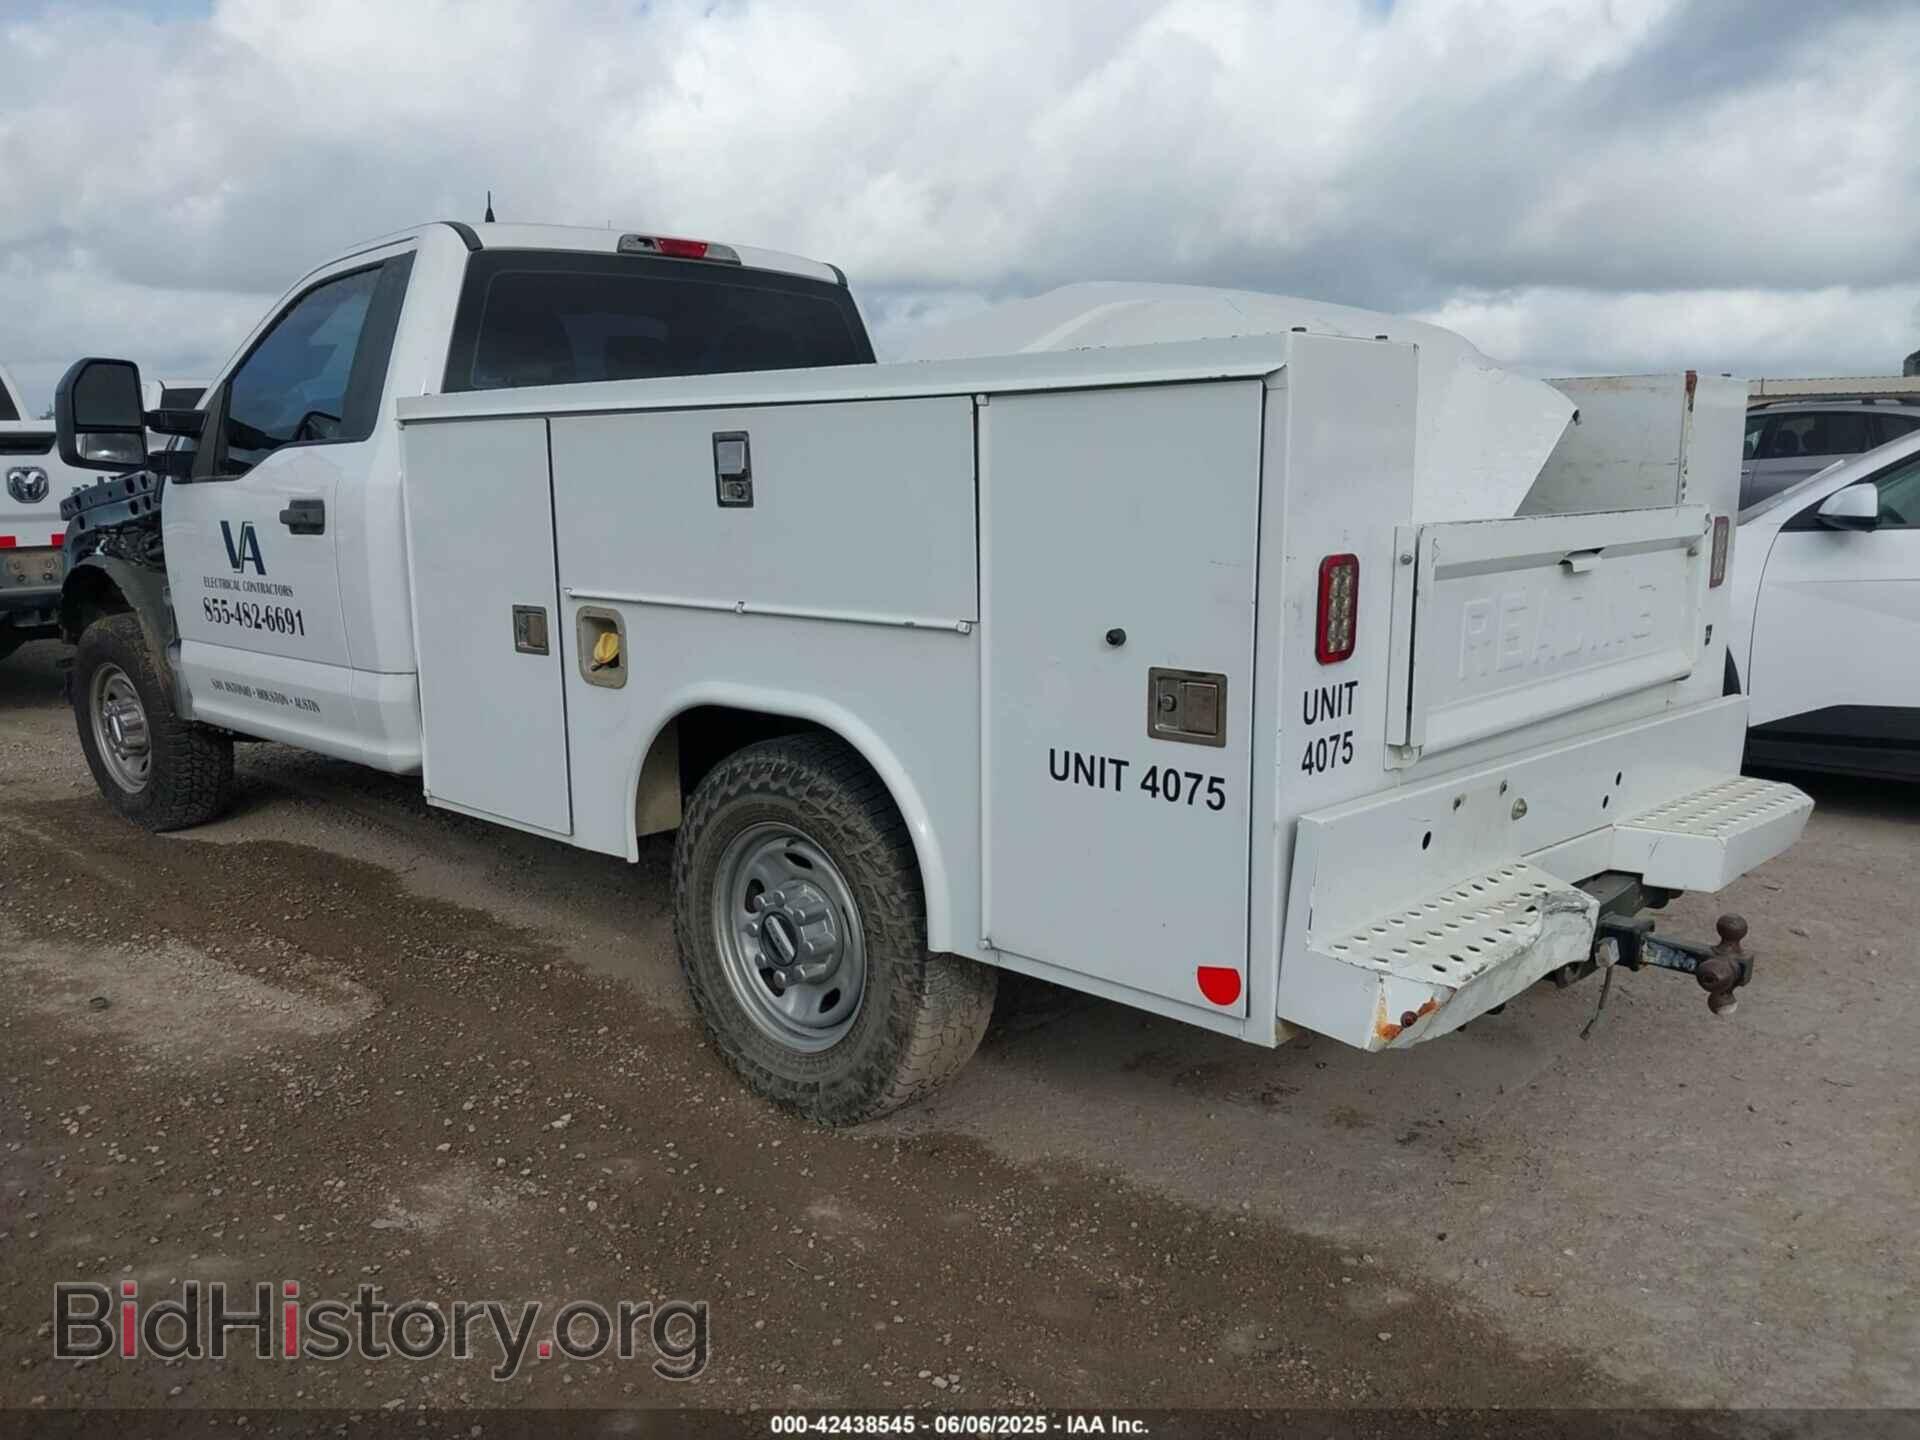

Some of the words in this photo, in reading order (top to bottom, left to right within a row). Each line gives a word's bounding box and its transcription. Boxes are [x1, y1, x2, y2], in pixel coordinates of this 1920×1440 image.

[203, 576, 241, 591] ELECTRICAL
[242, 580, 294, 597] CONTRACTORS
[203, 597, 304, 636] 855-482-6691
[1303, 680, 1358, 725] UNIT
[1301, 730, 1354, 776] 4075
[1049, 748, 1129, 792] UNIT
[1140, 765, 1226, 811] 4075
